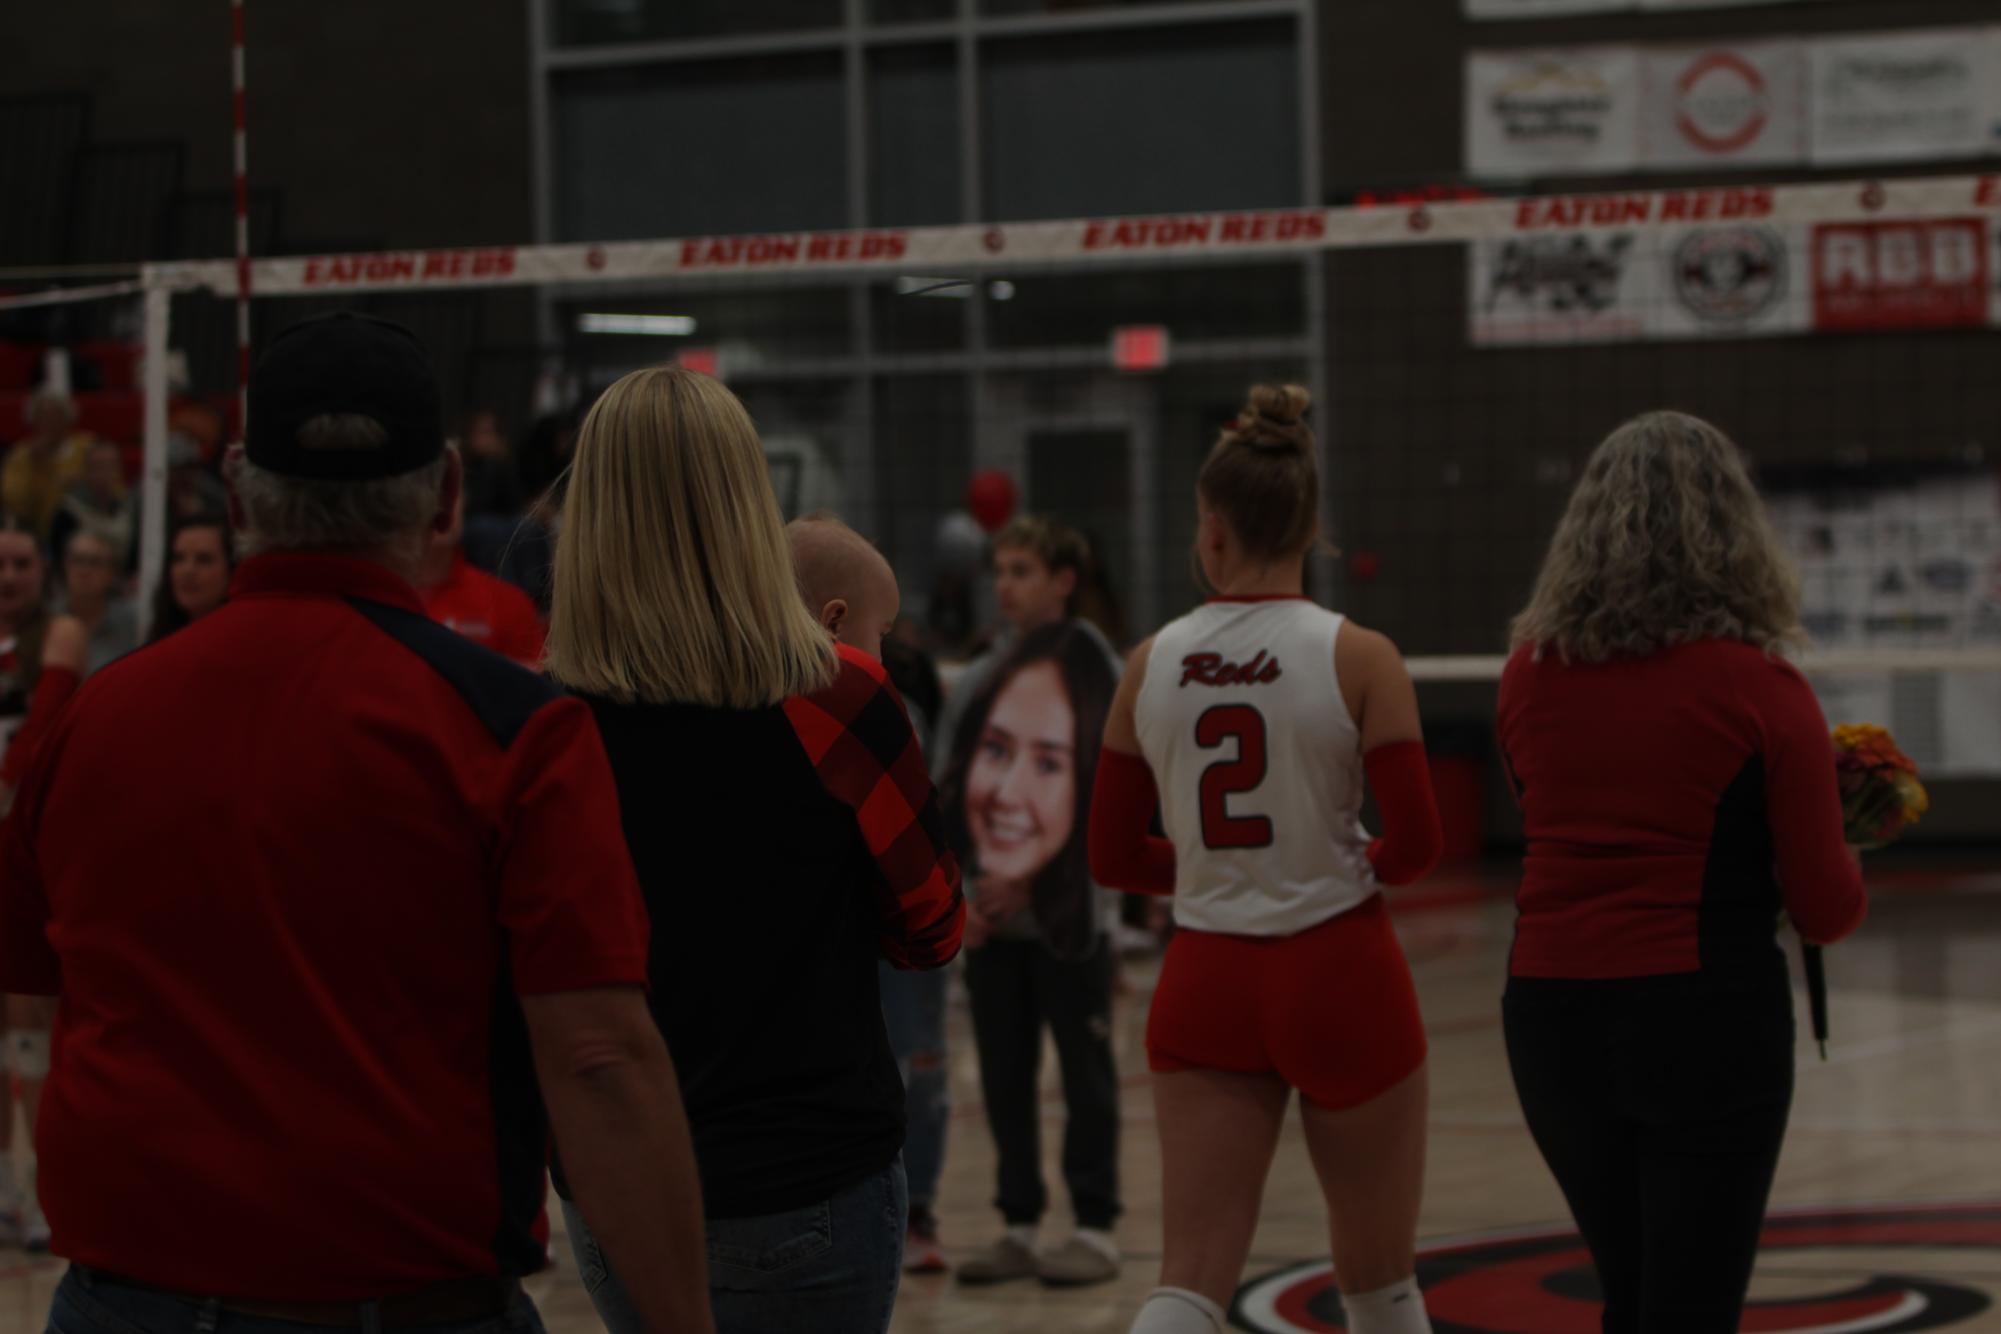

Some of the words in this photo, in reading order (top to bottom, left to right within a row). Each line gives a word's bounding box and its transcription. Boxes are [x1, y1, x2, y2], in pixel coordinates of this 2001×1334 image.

[1512, 194, 1651, 229] EATON
[1659, 186, 1775, 222] REDS
[1082, 218, 1211, 249] EATON
[1216, 211, 1327, 242] REDS
[303, 254, 415, 286] EATON
[420, 248, 517, 280] REDS
[677, 234, 799, 270] EATON
[805, 230, 907, 262] REDS
[1180, 649, 1282, 687] Reds
[1195, 703, 1273, 851] 2
